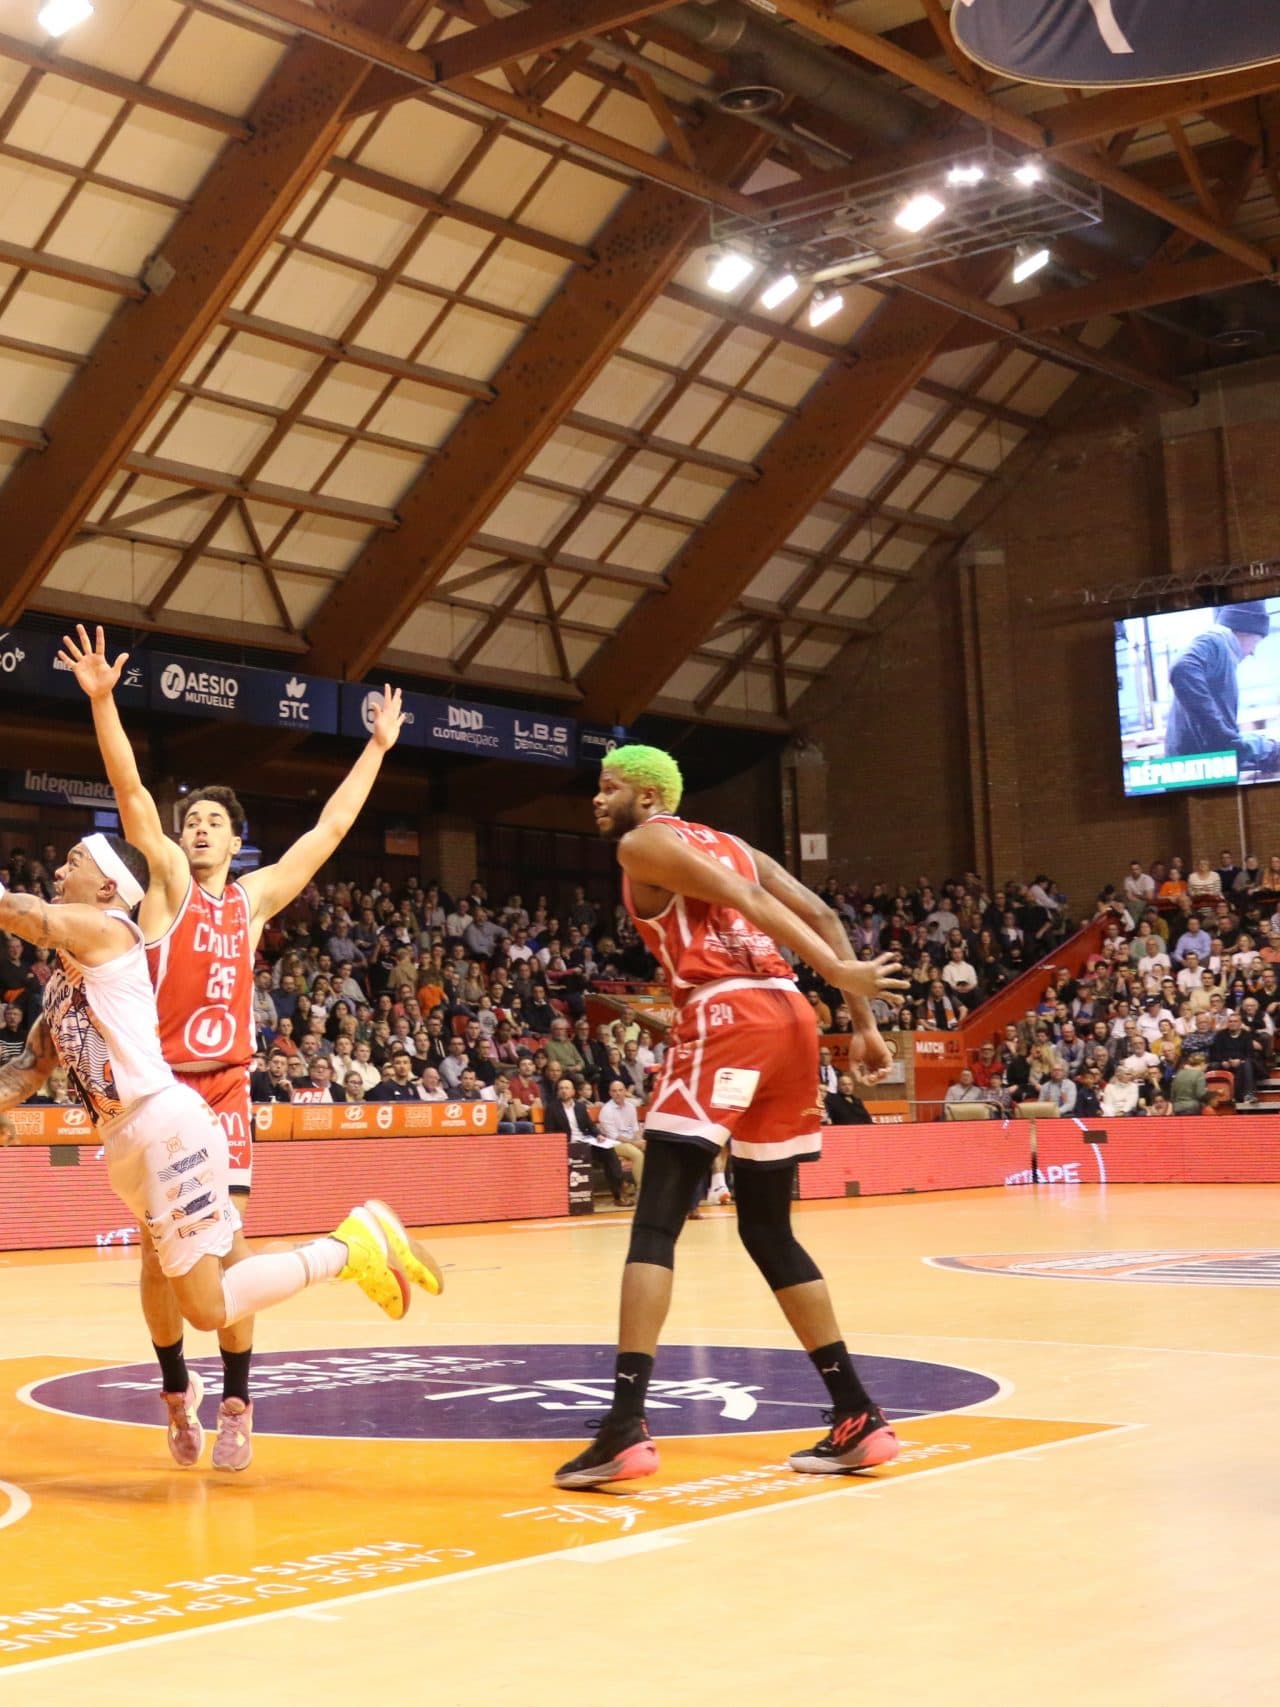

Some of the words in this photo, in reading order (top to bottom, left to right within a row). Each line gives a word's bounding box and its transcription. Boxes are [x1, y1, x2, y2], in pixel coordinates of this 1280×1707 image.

[186, 672, 238, 697] AÉSIO
[185, 692, 235, 709] MUTUELLE
[279, 700, 310, 720] STC
[916, 1041, 945, 1054] MATCH
[250, 1541, 424, 1576] HAUTS
[296, 1548, 476, 1584] CAISSE
[164, 1574, 257, 1592] DE
